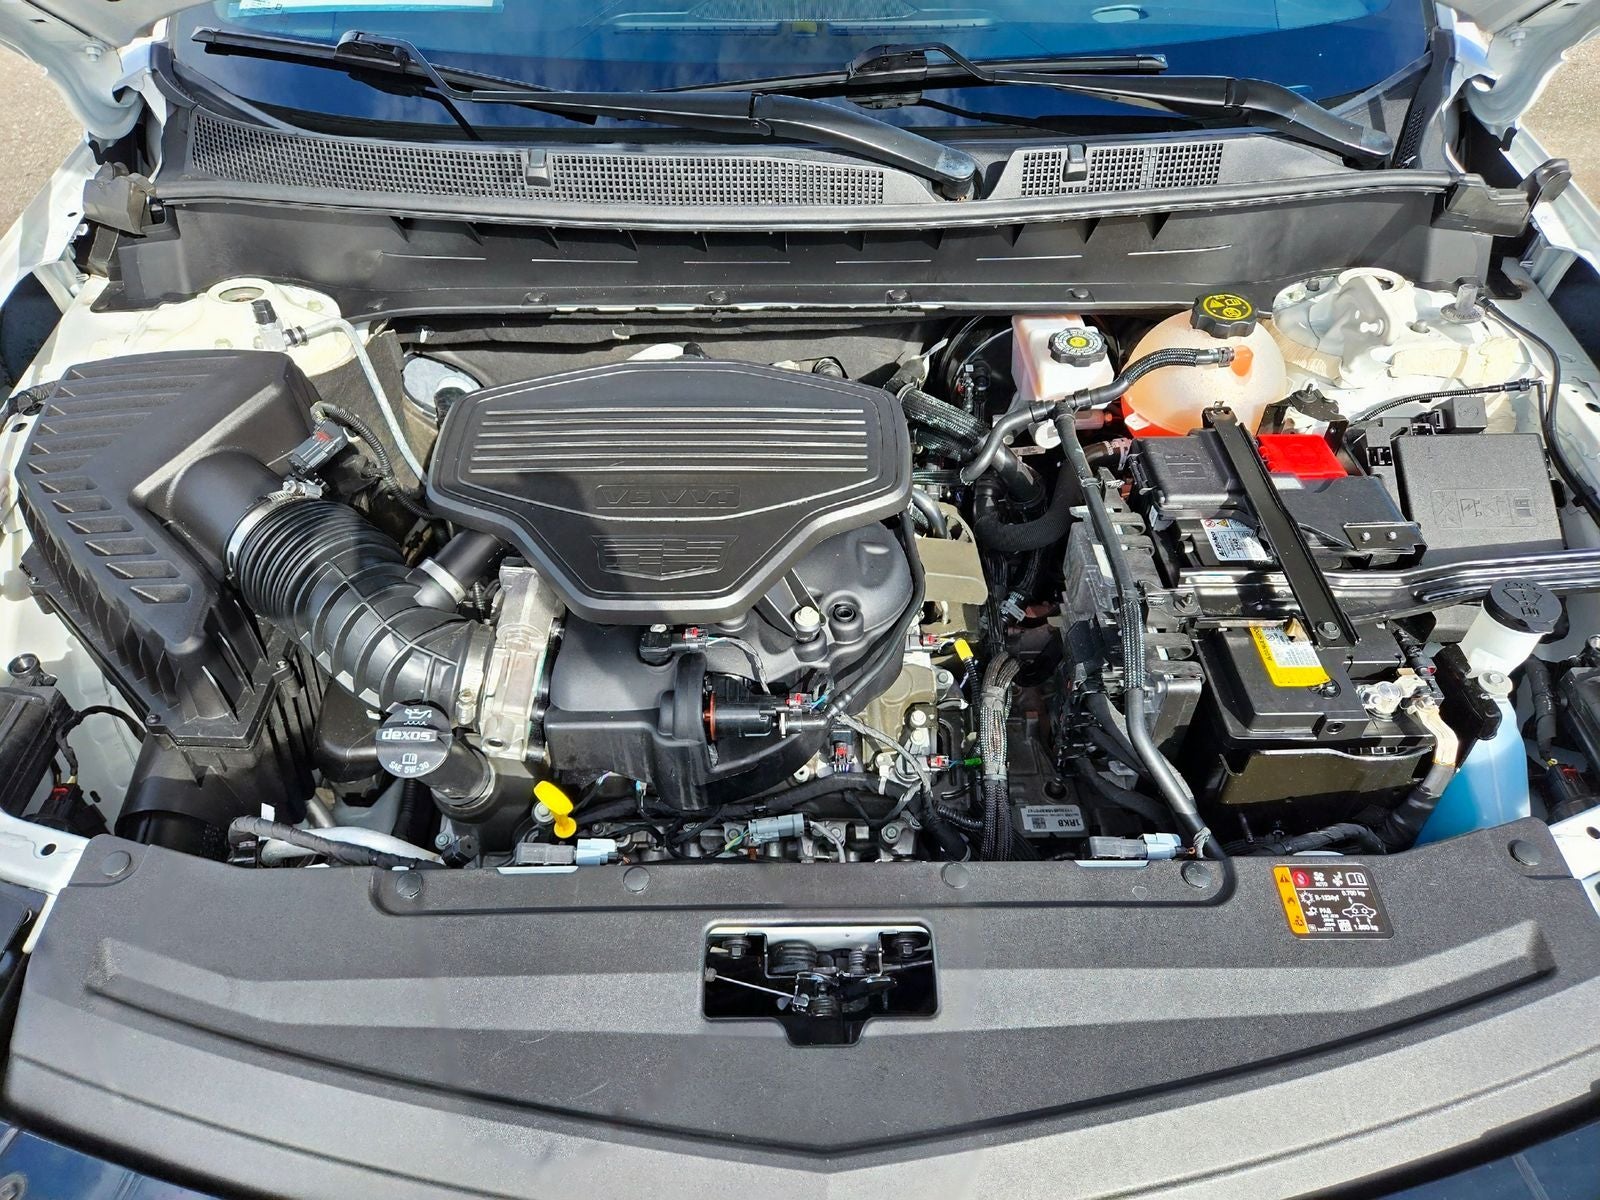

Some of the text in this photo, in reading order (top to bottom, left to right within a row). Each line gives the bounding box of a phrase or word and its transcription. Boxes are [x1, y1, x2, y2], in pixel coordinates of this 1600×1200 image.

[602, 489, 735, 504] V6 VVT
[381, 728, 432, 740] dexos
[388, 760, 430, 774] SAE 5W-30
